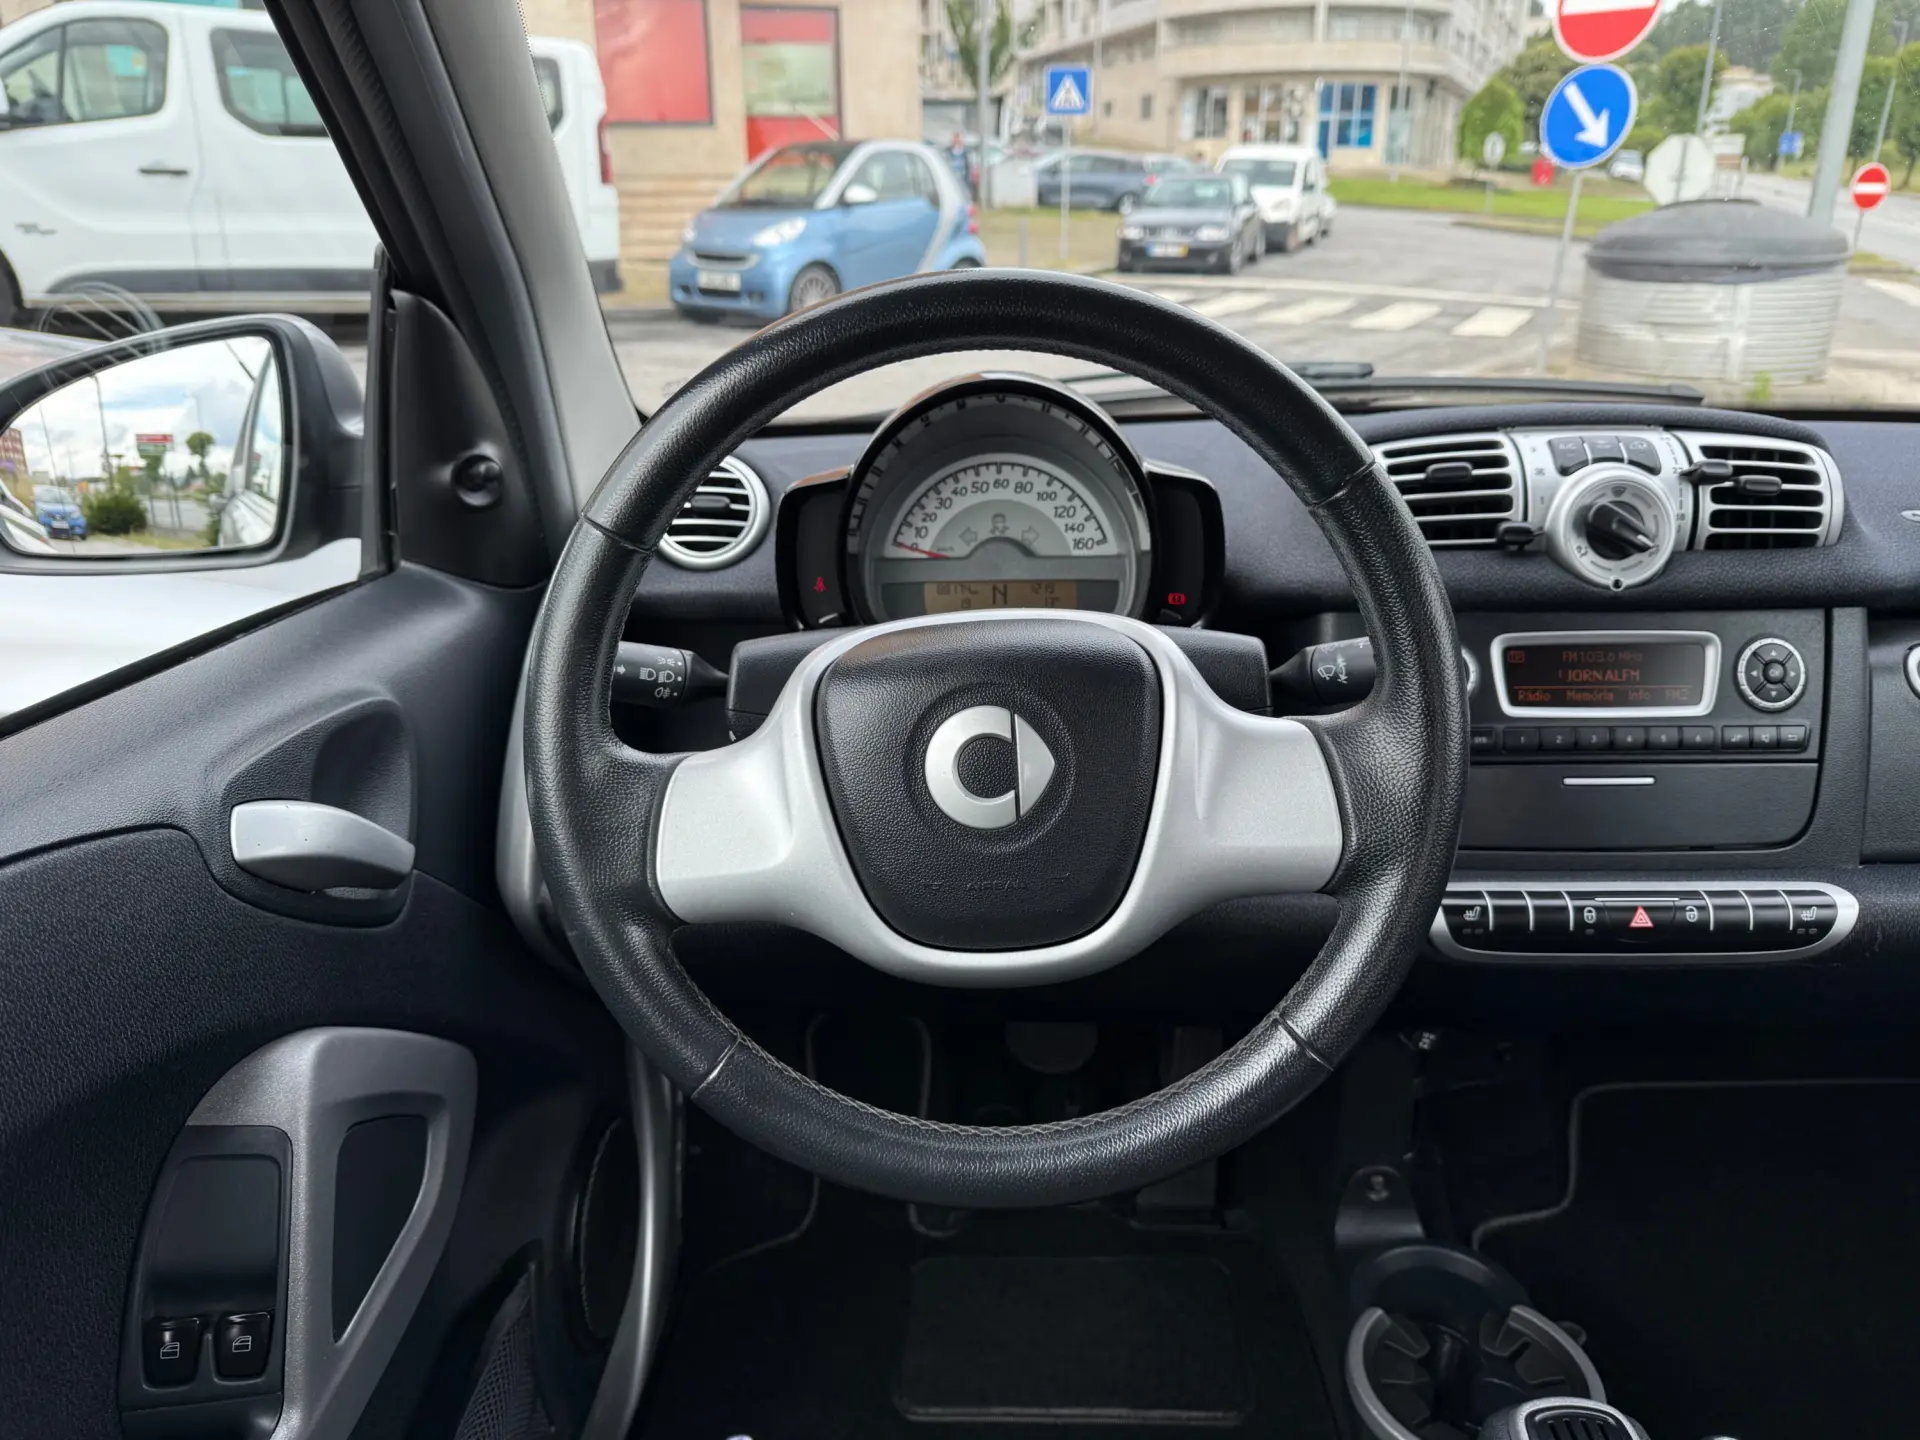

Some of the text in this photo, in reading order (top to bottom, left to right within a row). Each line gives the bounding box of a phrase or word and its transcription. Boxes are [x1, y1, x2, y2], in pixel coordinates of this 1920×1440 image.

[970, 481, 990, 494] 50
[993, 479, 1010, 489] 60
[1014, 481, 1034, 494] 80
[951, 486, 968, 497] 40
[1036, 491, 1058, 502] 100
[934, 497, 953, 510] 30
[921, 512, 938, 523] 20
[1053, 505, 1077, 519] 120
[913, 525, 928, 539] 10
[1064, 523, 1085, 533] 140
[1072, 537, 1095, 550] 160
[991, 583, 1008, 606] N
[1769, 669, 1781, 677] OK
[1517, 688, 1551, 702] Rádio
[1566, 688, 1615, 702] Memória
[1628, 689, 1651, 702] Info
